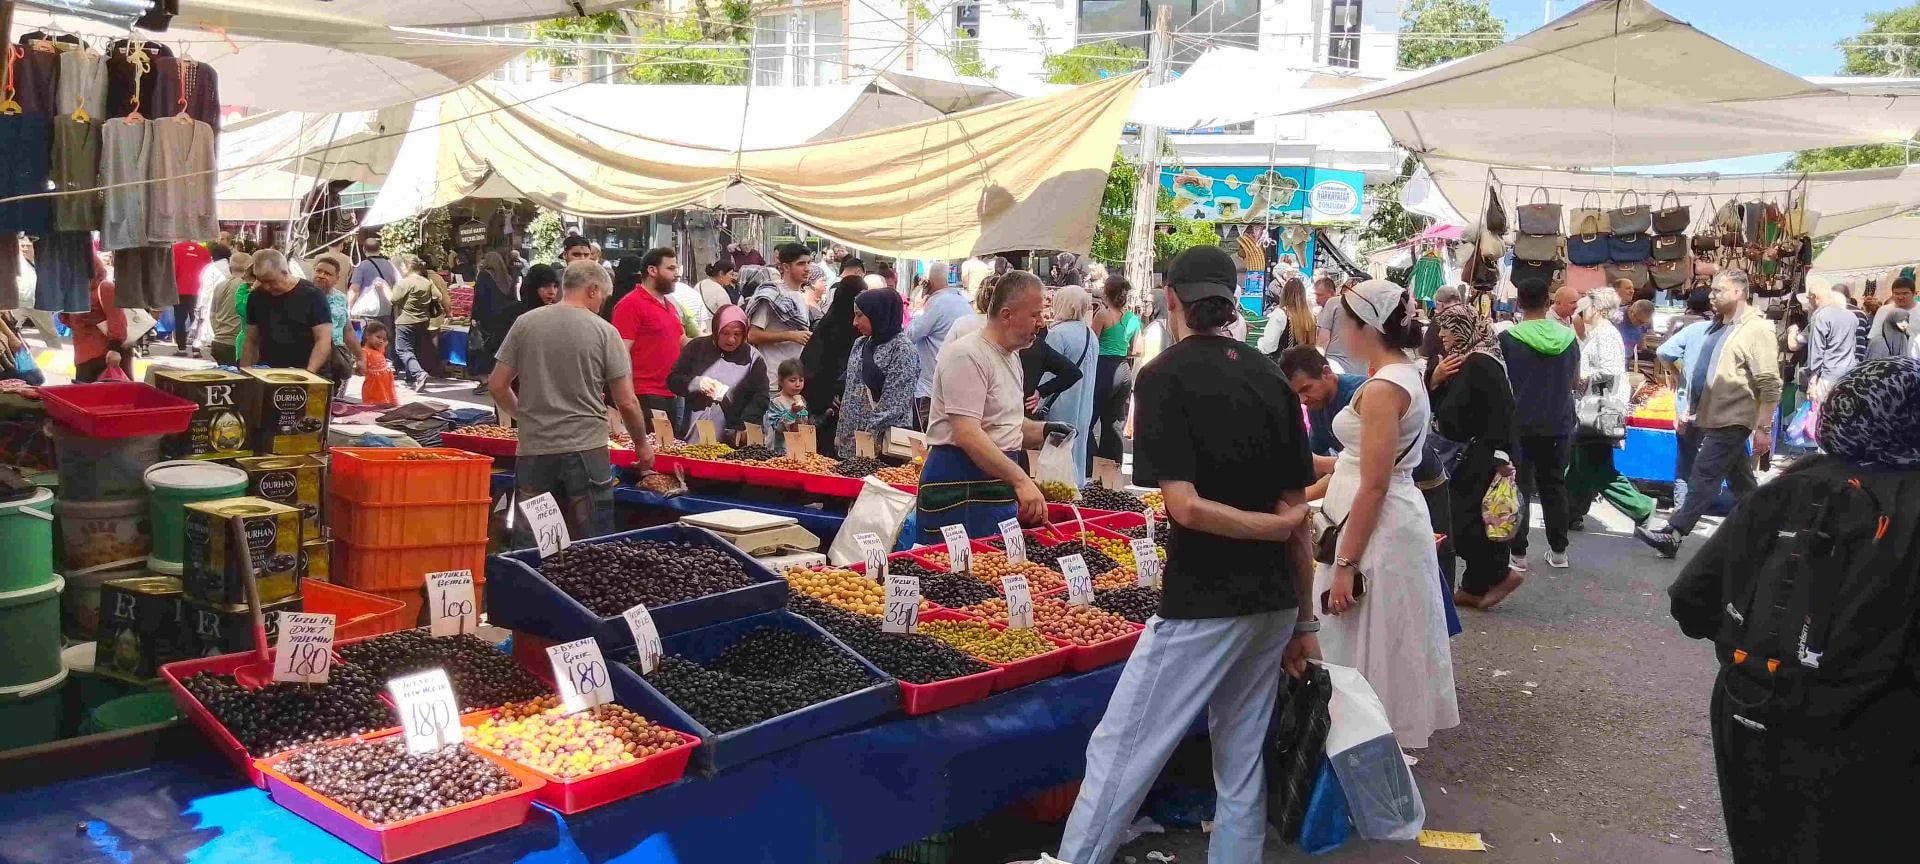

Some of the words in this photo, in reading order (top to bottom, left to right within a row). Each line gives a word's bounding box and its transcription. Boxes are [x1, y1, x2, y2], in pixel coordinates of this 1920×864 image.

[205, 384, 236, 407] ER
[275, 394, 305, 402] DURHAN
[262, 480, 295, 490] DURHAN
[246, 528, 274, 539] URHAN
[867, 548, 887, 570] 280
[1140, 559, 1161, 578] 320
[1069, 575, 1093, 597] 320
[440, 589, 473, 619] 100
[885, 601, 919, 627] 350
[1010, 594, 1031, 617] 200
[284, 643, 328, 676] 180
[569, 660, 606, 695] 180
[412, 699, 450, 738] 180
